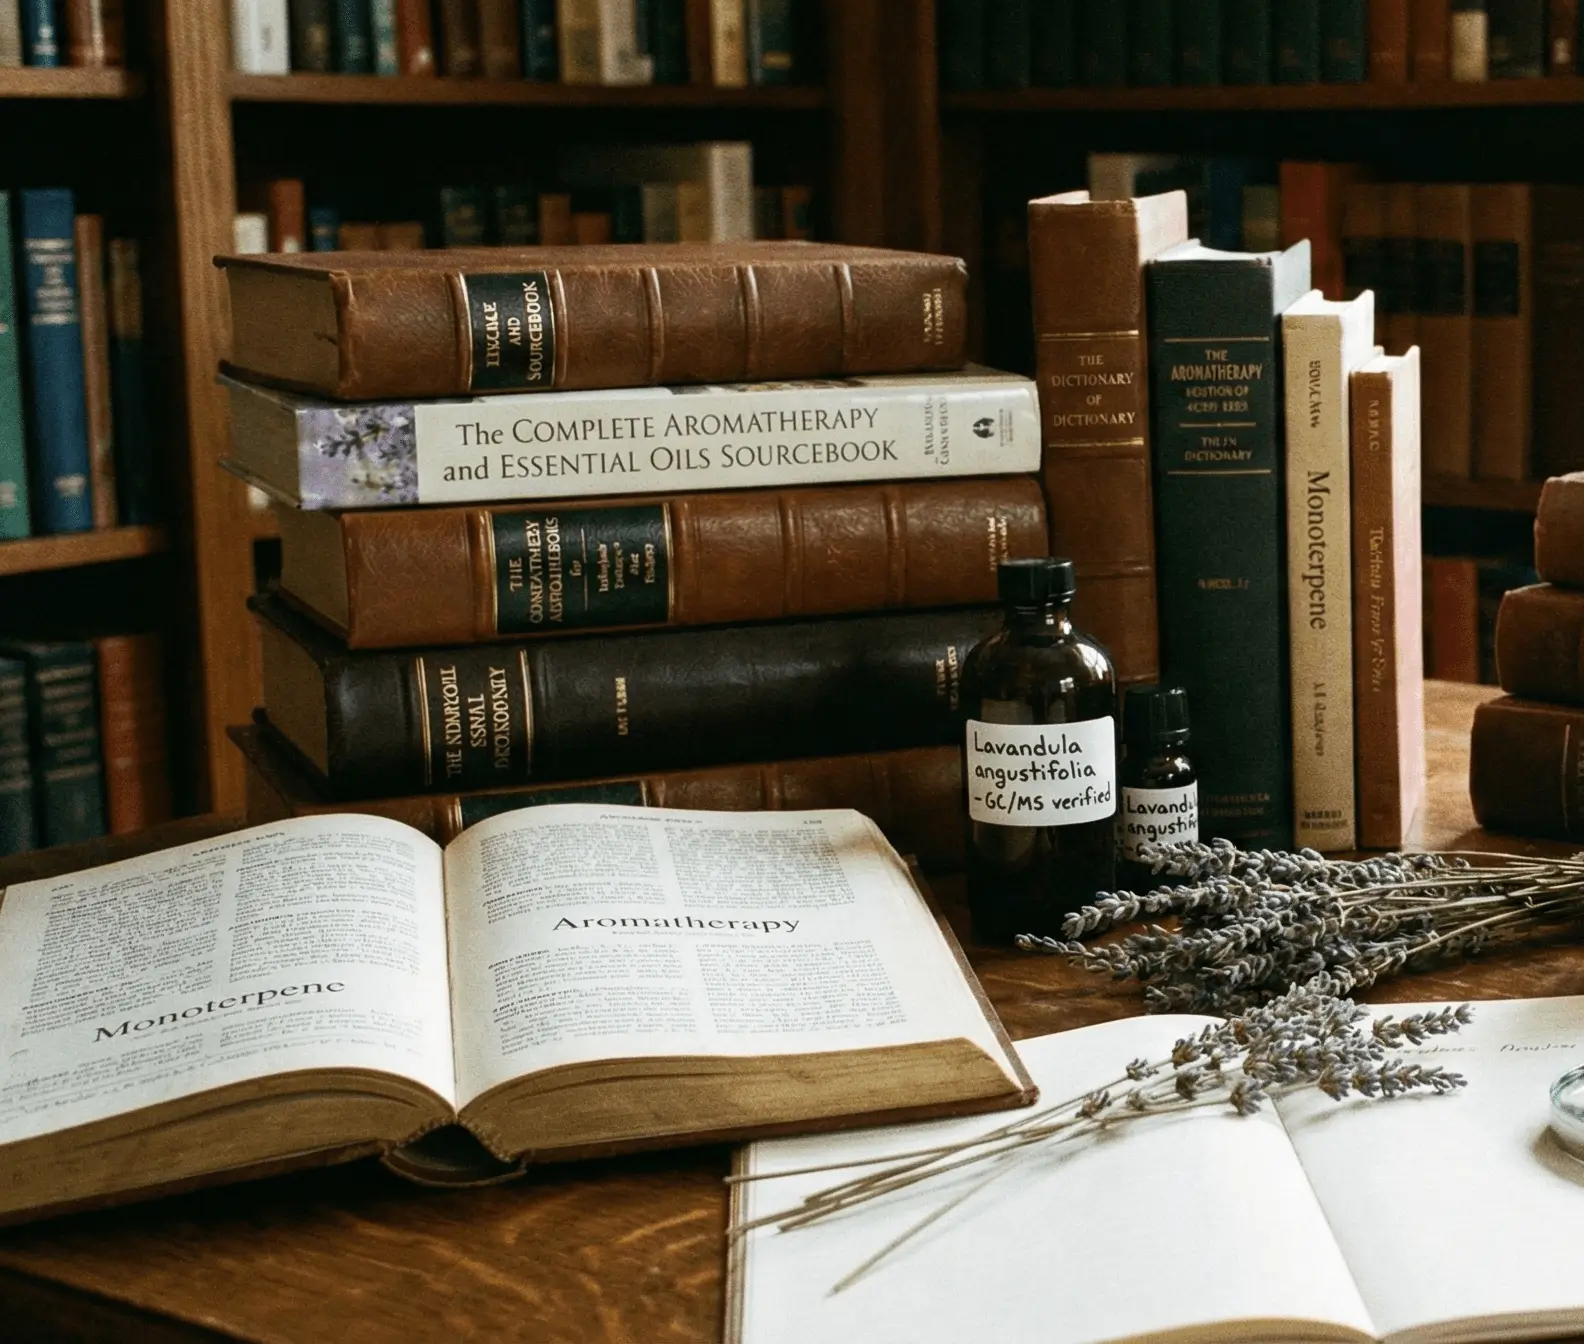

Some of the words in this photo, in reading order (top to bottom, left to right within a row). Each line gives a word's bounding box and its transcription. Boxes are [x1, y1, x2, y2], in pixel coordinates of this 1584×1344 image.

[1051, 371, 1135, 388] DICTIONARY
[1086, 394, 1103, 406] OF
[455, 423, 504, 446] The
[512, 416, 656, 443] COMPLETE
[664, 407, 879, 438] AROMATHERAPY
[1053, 411, 1137, 428] DICTIONARY
[443, 456, 490, 482] and
[500, 451, 642, 479] ESSENTIAL
[650, 446, 711, 471] OILS
[721, 439, 899, 468] SOURCEBOOK
[1301, 470, 1331, 631] Monoterpene
[974, 731, 1083, 756] Lavandula
[975, 760, 1097, 789] angustifolia
[1052, 781, 1112, 810] verified
[552, 916, 800, 934] Aromatherapy
[92, 980, 346, 1043] Monoterpene
